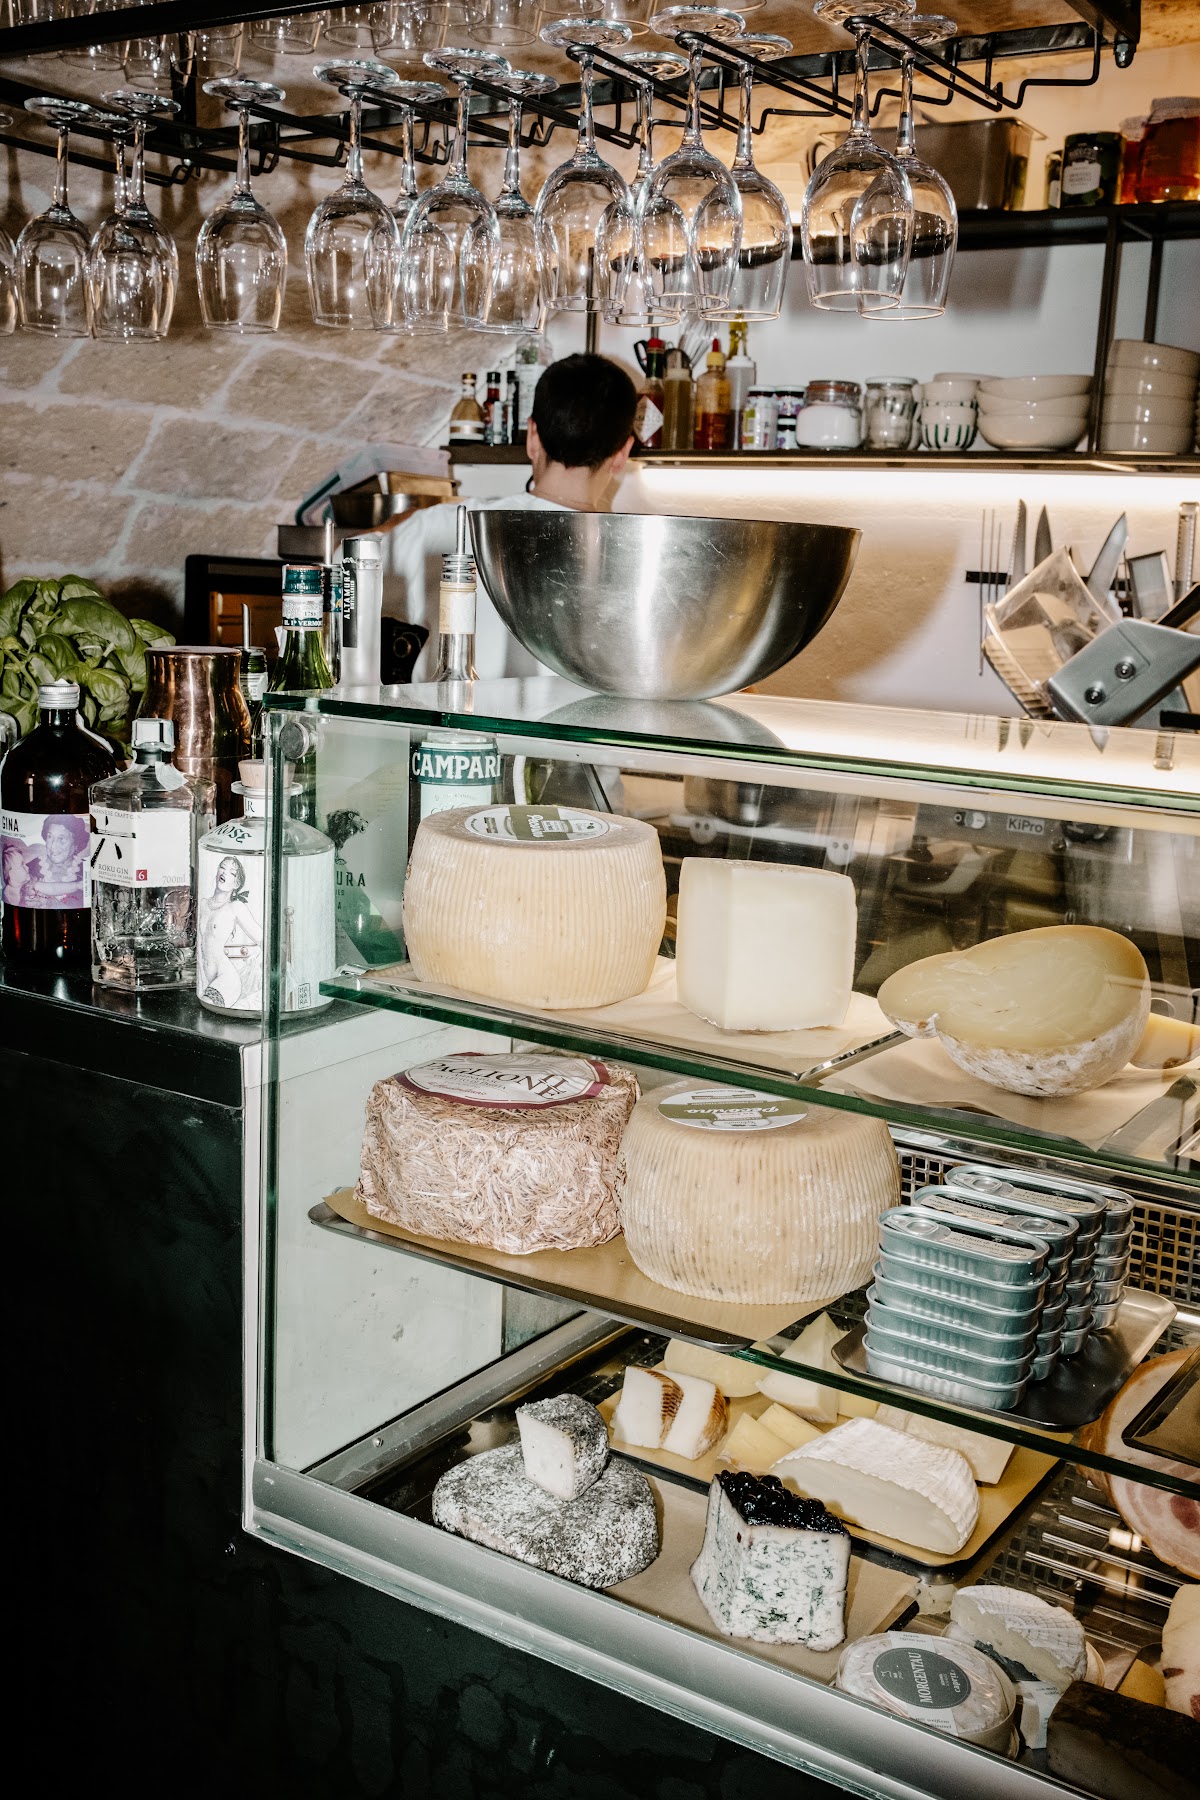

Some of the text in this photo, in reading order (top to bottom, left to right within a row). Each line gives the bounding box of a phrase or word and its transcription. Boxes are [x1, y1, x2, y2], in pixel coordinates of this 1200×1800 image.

[343, 570, 351, 620] ALTAMURA
[2, 816, 19, 832] GINA
[1008, 817, 1043, 833] KiPro
[98, 863, 129, 875] ROKU GIN
[138, 872, 145, 880] 6
[908, 1652, 933, 1704] MORGENTAU
